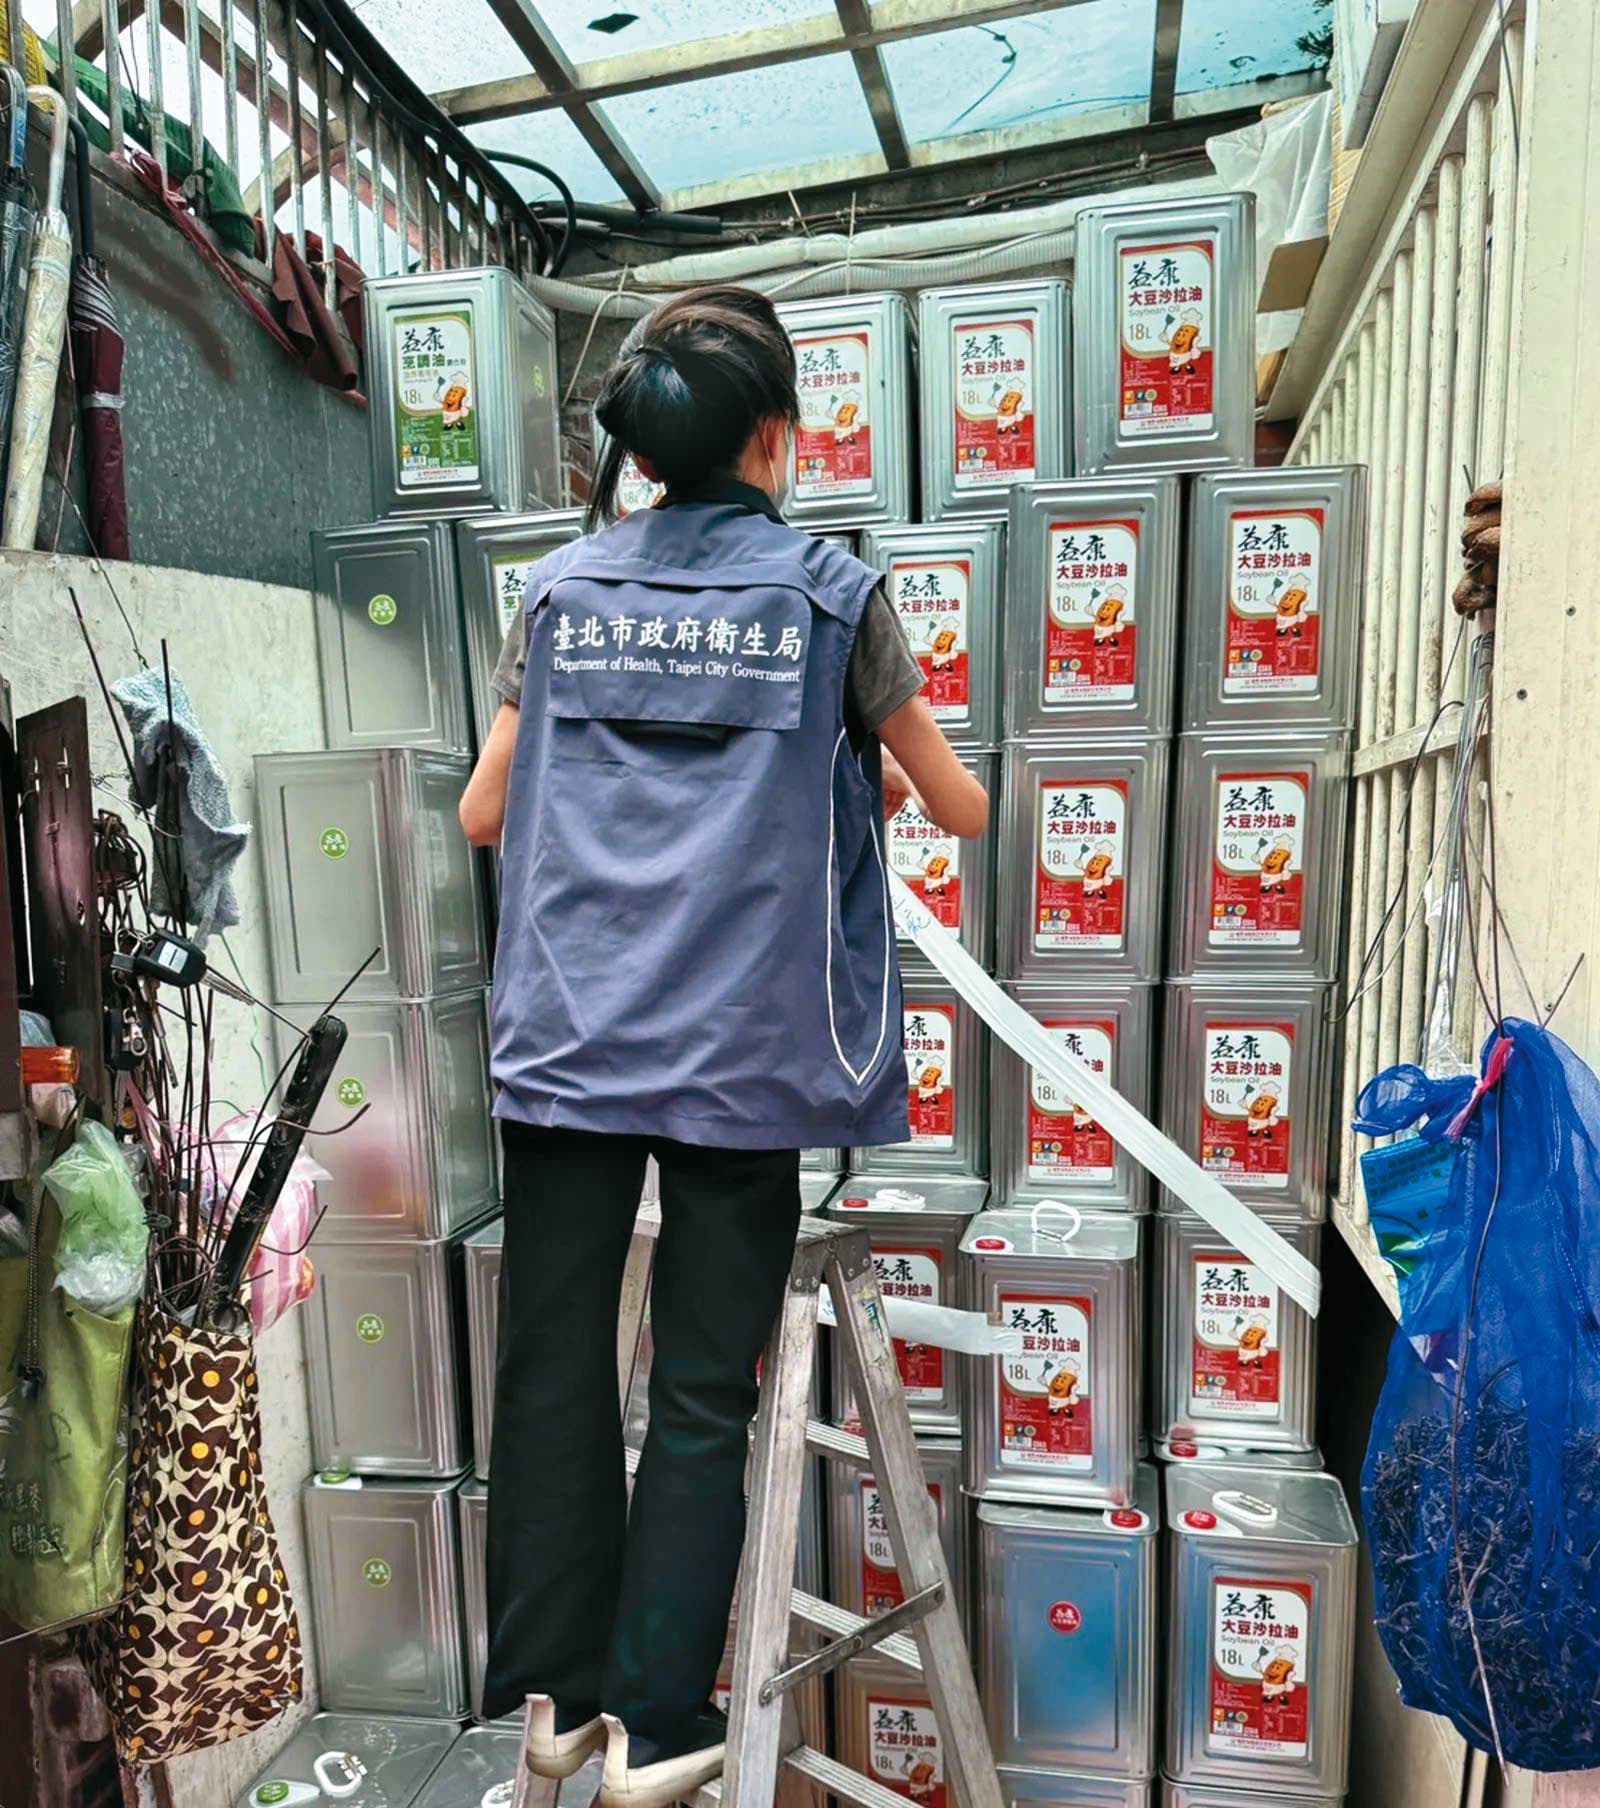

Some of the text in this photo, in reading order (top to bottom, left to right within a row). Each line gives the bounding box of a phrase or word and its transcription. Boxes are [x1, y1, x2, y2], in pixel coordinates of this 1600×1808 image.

[1128, 258, 1180, 289] 益康
[1129, 286, 1203, 307] 大豆沙拉油
[1129, 304, 1181, 318] Soybean Oil
[401, 327, 444, 354] 益康
[961, 335, 1006, 362] 益康
[799, 348, 842, 375] 益康
[961, 358, 1025, 375] 大豆沙拉油
[799, 371, 861, 388] 大豆沙拉油
[1237, 524, 1289, 552] 益康
[1056, 535, 1107, 563] 益康
[1237, 553, 1312, 570] 大豆沙拉油
[1056, 563, 1128, 580] 大豆沙拉油
[1237, 569, 1289, 580] Soybean Oil
[899, 574, 942, 599] 益康
[1056, 579, 1106, 590] Soybean Oil
[899, 598, 960, 614] 大豆沙拉油
[553, 613, 802, 662] 臺北市政府衛生局
[554, 656, 800, 682] Department of Health, Taipei City Government
[1047, 793, 1096, 819] 益康
[1223, 786, 1275, 813] 益康
[1047, 820, 1117, 835] 大豆沙拉油
[1223, 814, 1296, 829] 大豆沙拉油
[1223, 829, 1274, 838] Soybean Oil
[906, 1015, 928, 1038] 康
[903, 1038, 945, 1051] 豆沙拉油
[1211, 1034, 1261, 1060] 益康
[1210, 1061, 1282, 1076] 大豆沙拉油
[1210, 1076, 1260, 1085] Soybean Oil
[1201, 1268, 1249, 1292] 益康
[878, 1283, 933, 1297] 豆沙拉油
[1201, 1293, 1271, 1309] 大豆沙拉油
[1009, 1308, 1058, 1335] 益康
[1022, 1335, 1081, 1352] 豆沙拉油
[1222, 1592, 1276, 1620] 益康
[1221, 1620, 1299, 1639] 大豆沙拉油
[1221, 1635, 1275, 1646] Soybean Oil
[874, 1707, 918, 1733] 益康
[874, 1730, 937, 1748] 大豆沙拉油
